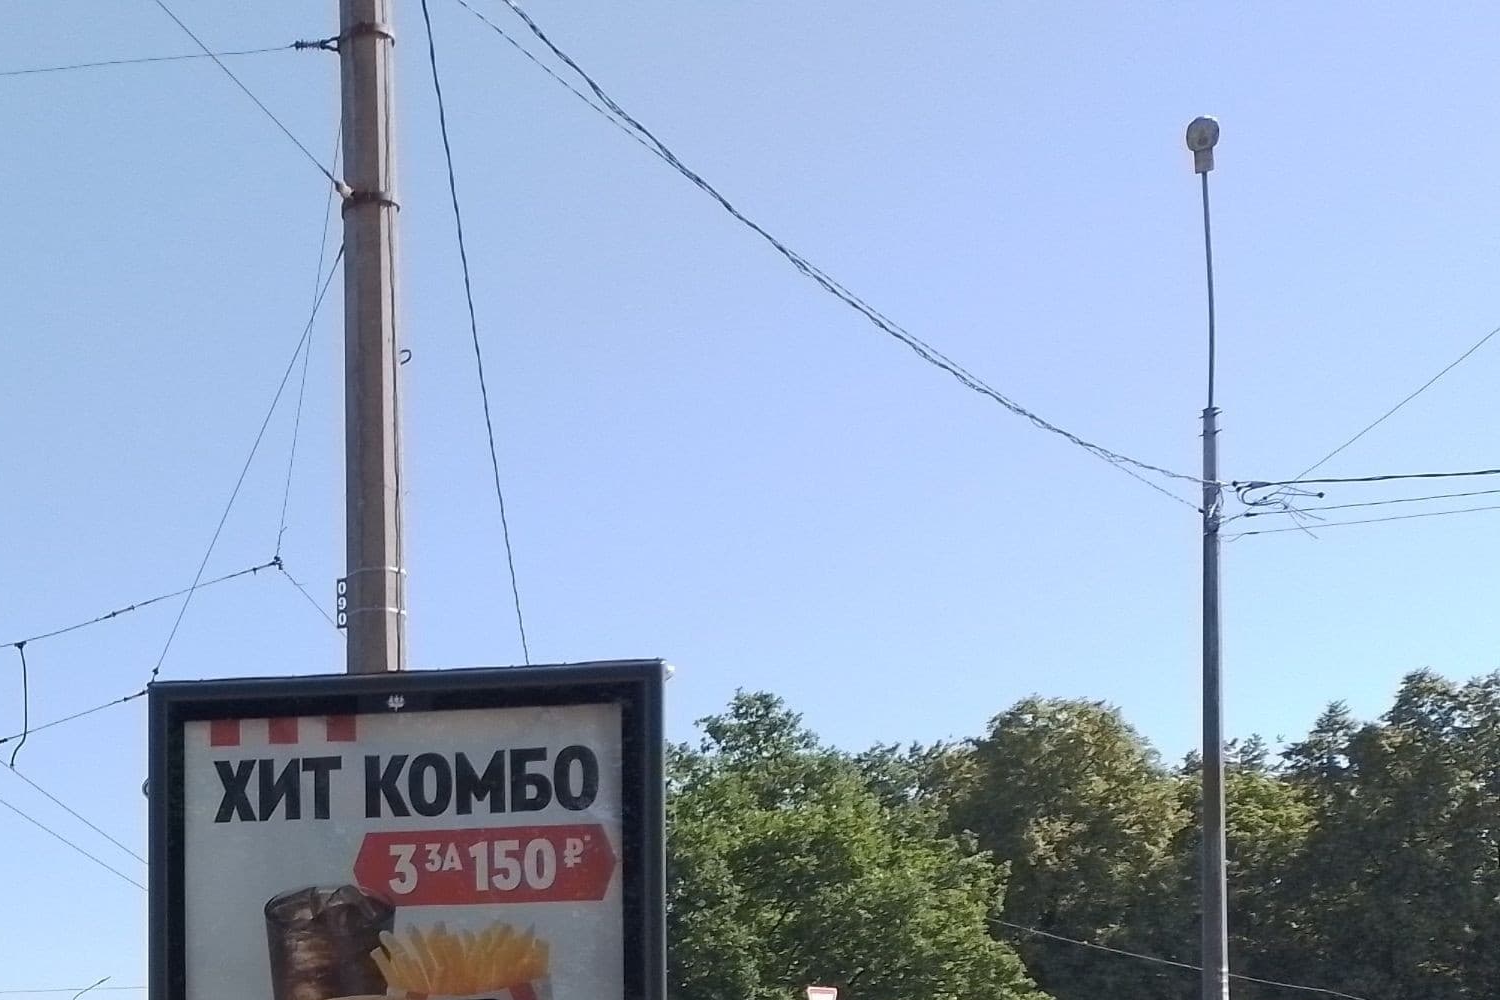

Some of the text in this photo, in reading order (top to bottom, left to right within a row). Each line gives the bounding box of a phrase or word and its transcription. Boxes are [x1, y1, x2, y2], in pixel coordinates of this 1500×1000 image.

[213, 745, 599, 823] ХИТ КОМБО
[388, 843, 419, 895] 3
[424, 842, 464, 872] ЗА
[468, 838, 557, 892] 150
